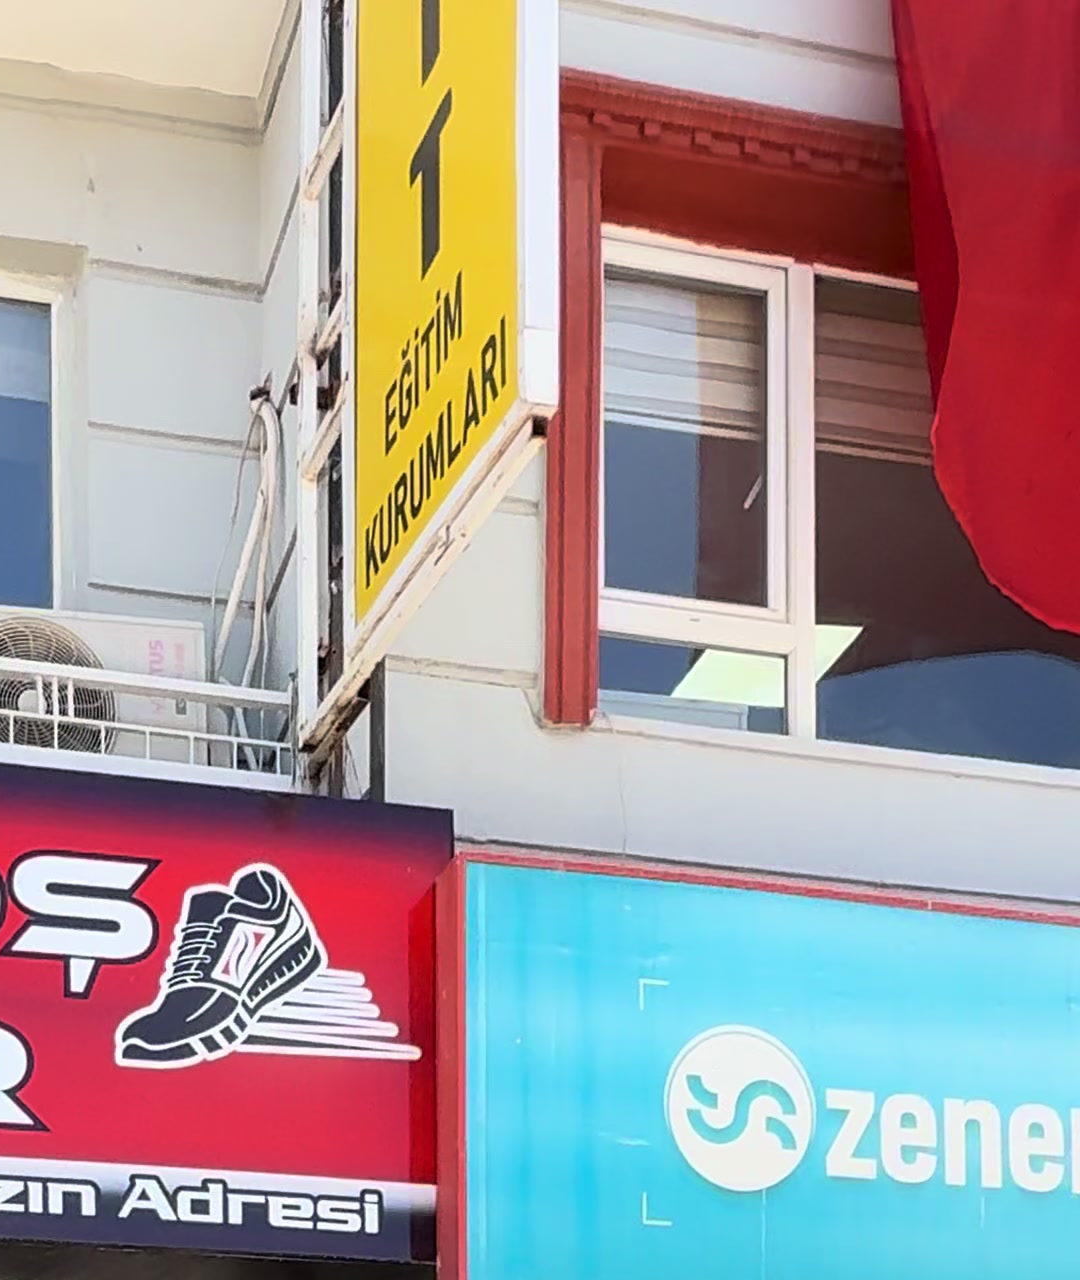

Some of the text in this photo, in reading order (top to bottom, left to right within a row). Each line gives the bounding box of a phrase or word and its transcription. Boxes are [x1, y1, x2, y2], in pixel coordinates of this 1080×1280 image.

[384, 269, 462, 457] EĞİTİM
[365, 314, 507, 590] KURUMLARI
[118, 1175, 381, 1235] Adresi
[824, 1087, 1080, 1196] zene
